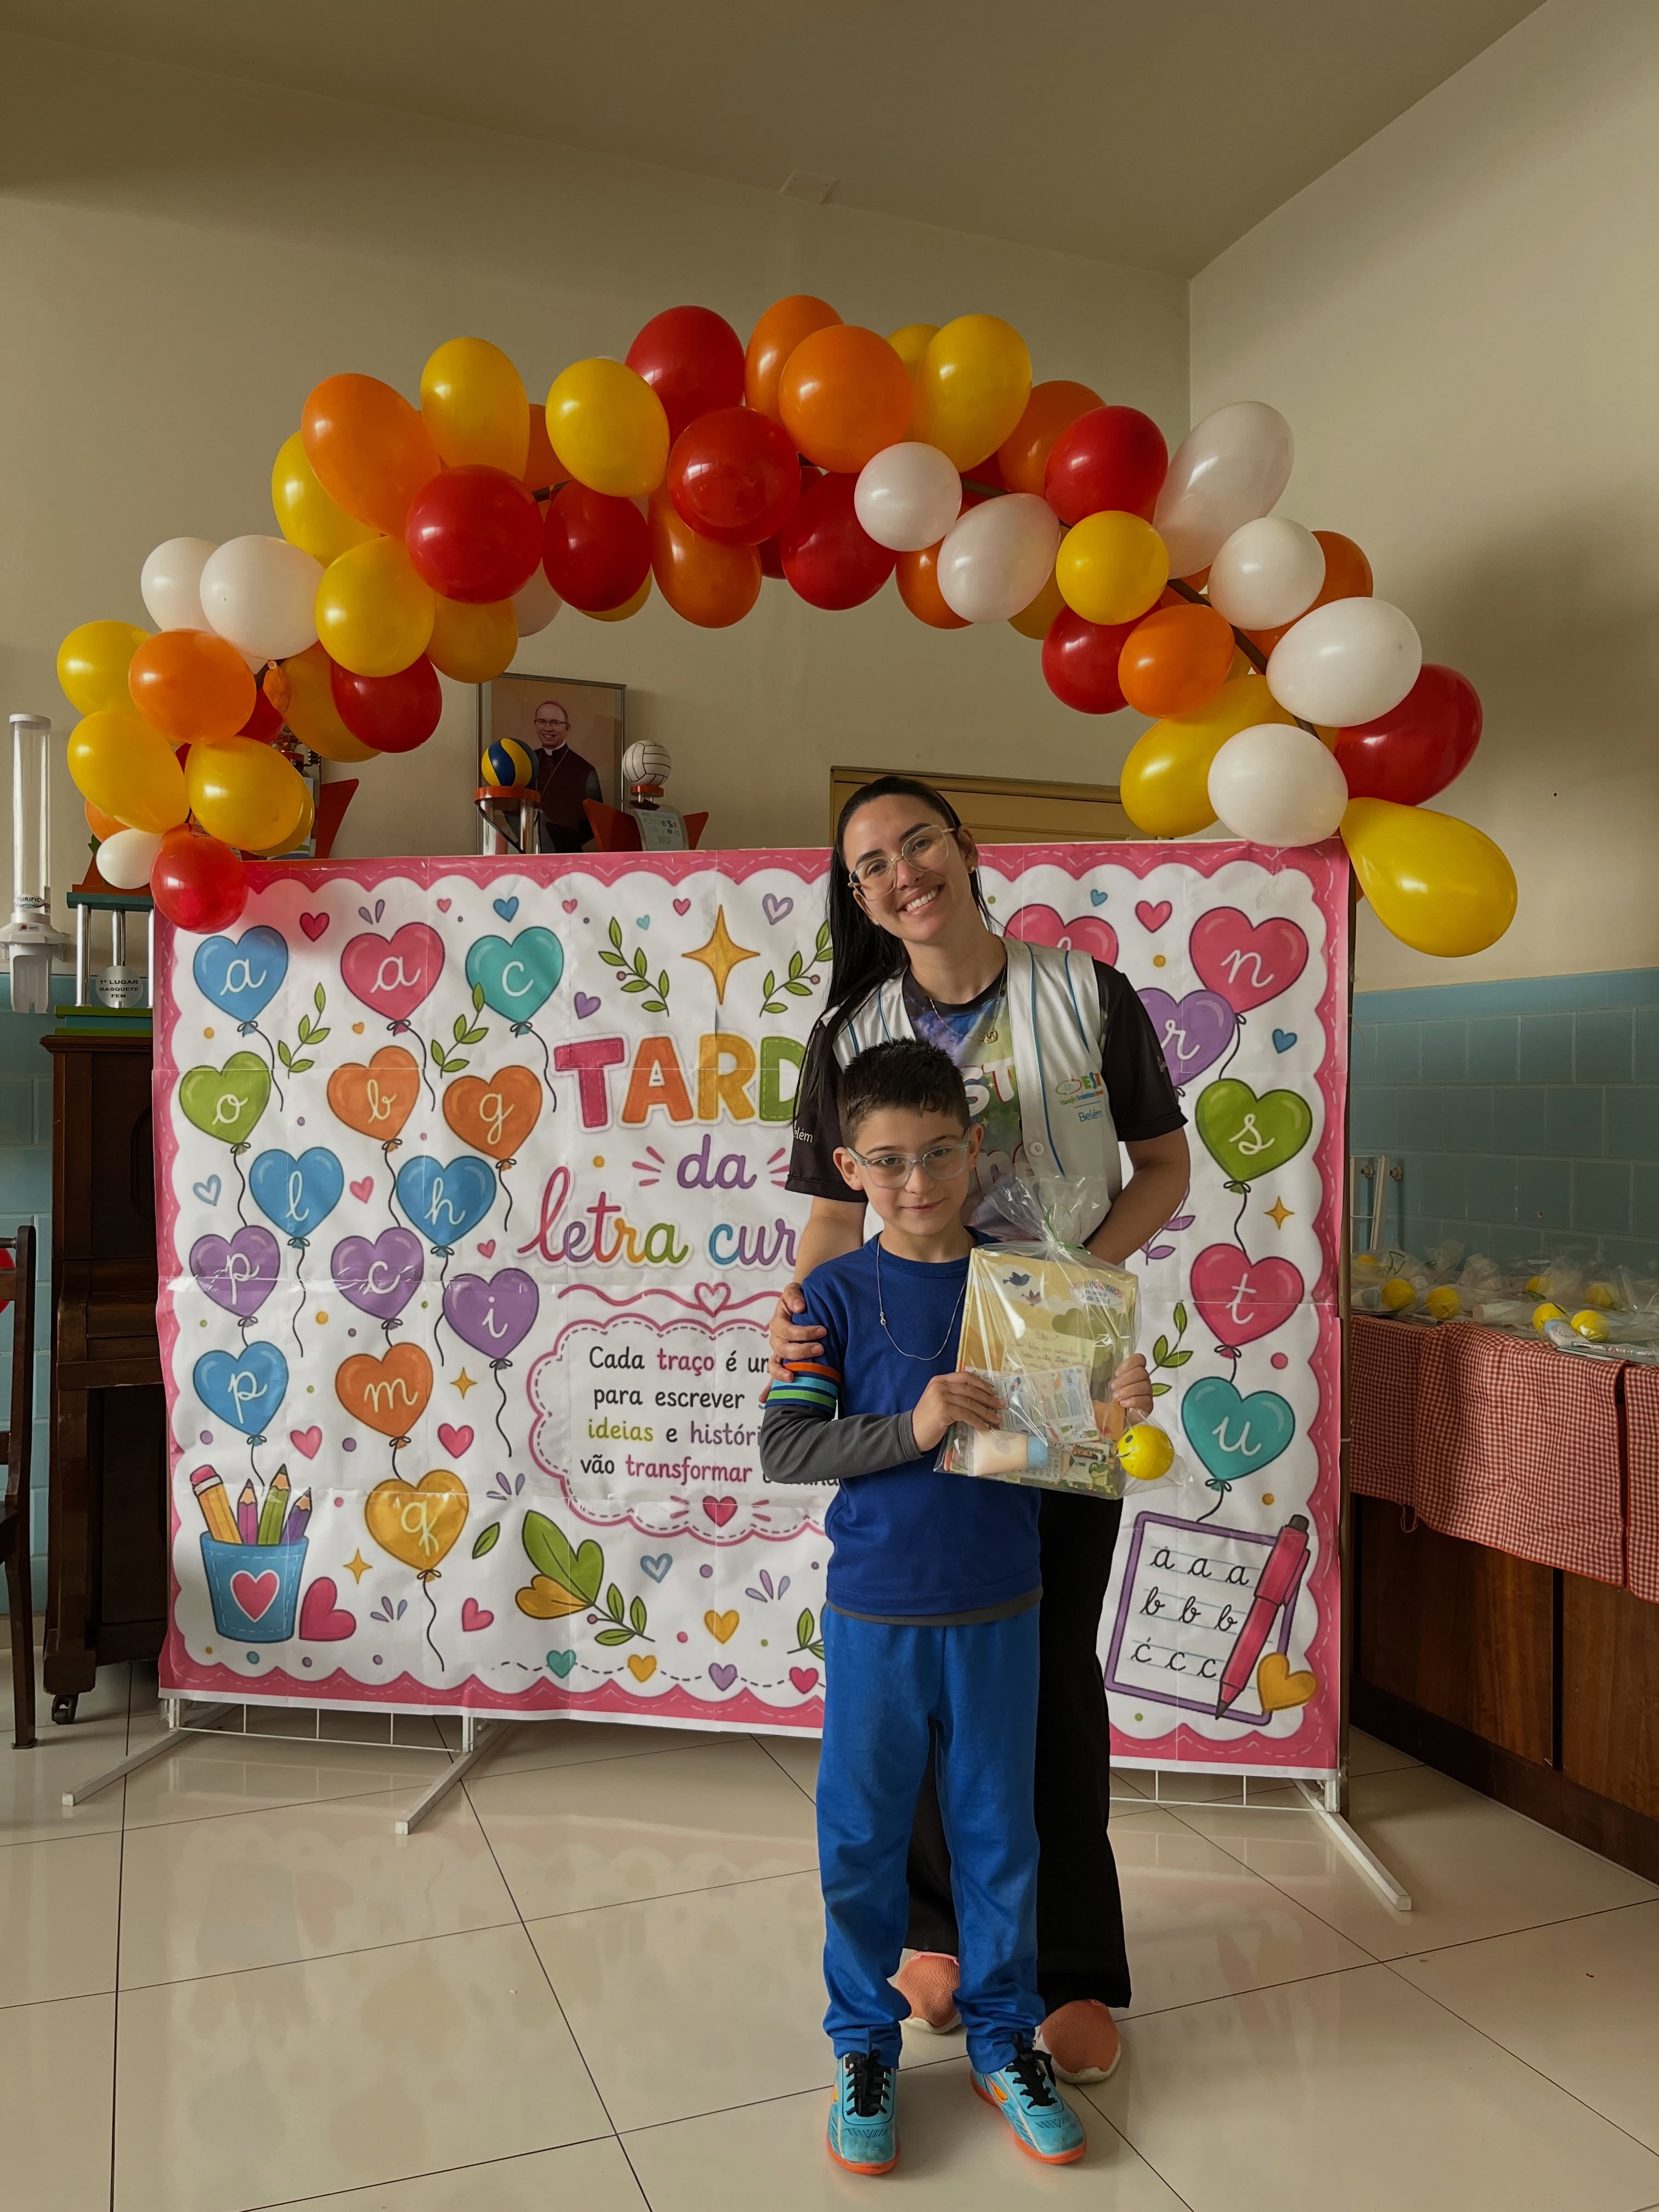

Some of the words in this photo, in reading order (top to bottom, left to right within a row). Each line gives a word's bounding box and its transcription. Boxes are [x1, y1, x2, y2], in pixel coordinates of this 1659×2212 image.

[220, 959, 266, 996] a
[370, 956, 421, 994] a
[1220, 949, 1274, 988] n
[1161, 1019, 1200, 1060] r
[212, 1094, 248, 1125] o
[367, 1079, 398, 1124] b
[478, 1093, 516, 1145] g
[1078, 1108, 1103, 1122] Belém
[1229, 1113, 1275, 1154] s
[677, 1134, 757, 1189] da
[286, 1171, 309, 1221] l
[424, 1177, 466, 1225] h
[517, 1166, 689, 1264] letra
[709, 1218, 797, 1266] cur
[224, 1253, 259, 1305] p
[1226, 1273, 1256, 1324] t
[482, 1296, 507, 1339] i
[589, 1346, 645, 1370] Cada
[658, 1348, 714, 1376] traço
[726, 1351, 738, 1372] é
[228, 1372, 268, 1424] p
[364, 1378, 419, 1413] m
[594, 1389, 644, 1409] para
[654, 1391, 745, 1409] escrever
[588, 1417, 653, 1442] ideias
[666, 1427, 678, 1443] e
[1075, 1444, 1104, 1454] Monteiro
[1212, 1417, 1261, 1456] u
[580, 1454, 615, 1475] vão
[626, 1455, 753, 1485] transformar
[1188, 1558, 1212, 1578] a
[1225, 1565, 1249, 1585] a
[1140, 1587, 1165, 1615] b
[1178, 1596, 1201, 1623] b
[1214, 1605, 1238, 1631] b
[1165, 1652, 1186, 1671] c
[1198, 1658, 1216, 1678] c
